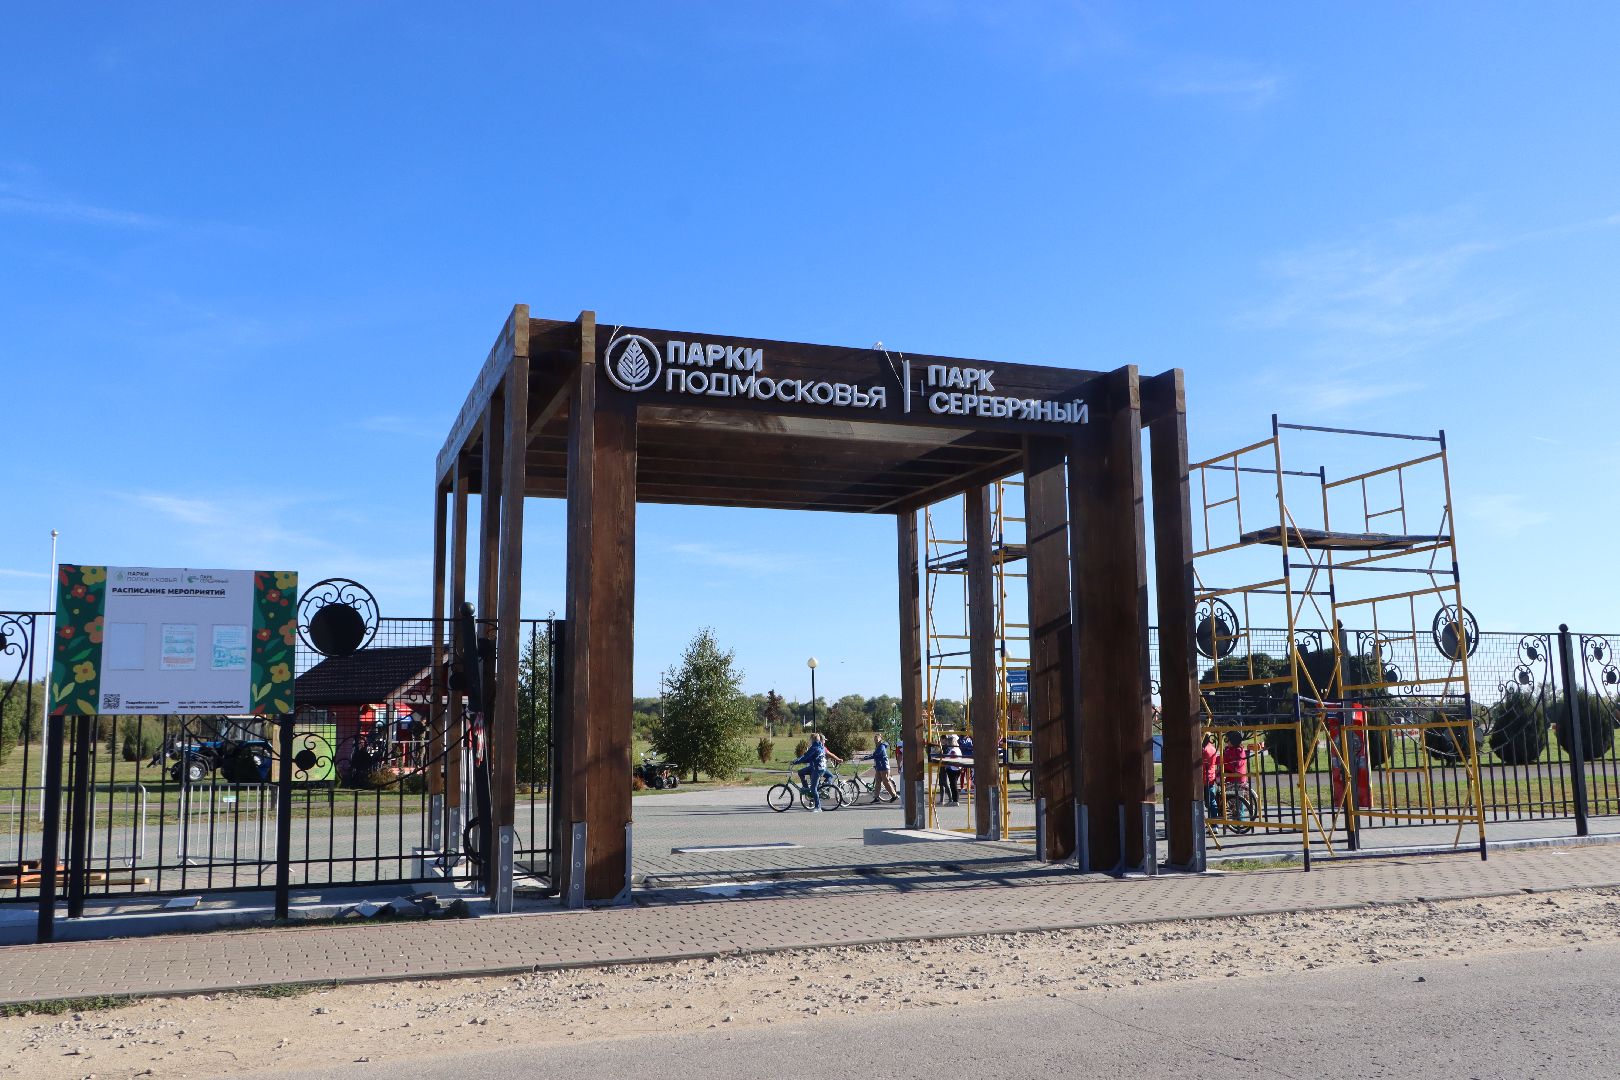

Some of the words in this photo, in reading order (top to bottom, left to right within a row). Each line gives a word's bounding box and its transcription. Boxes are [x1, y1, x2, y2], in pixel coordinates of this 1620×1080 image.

[666, 340, 764, 371] ПАРКИ
[665, 368, 887, 409] ПОДМОСКОВЬЯ
[927, 364, 996, 392] ПАРК
[928, 391, 1089, 425] СЕРЕБРЯНЫЙ
[111, 587, 166, 595] РАСПИСАНИЕ
[167, 588, 226, 596] МЕРОПРИЯТИЙ
